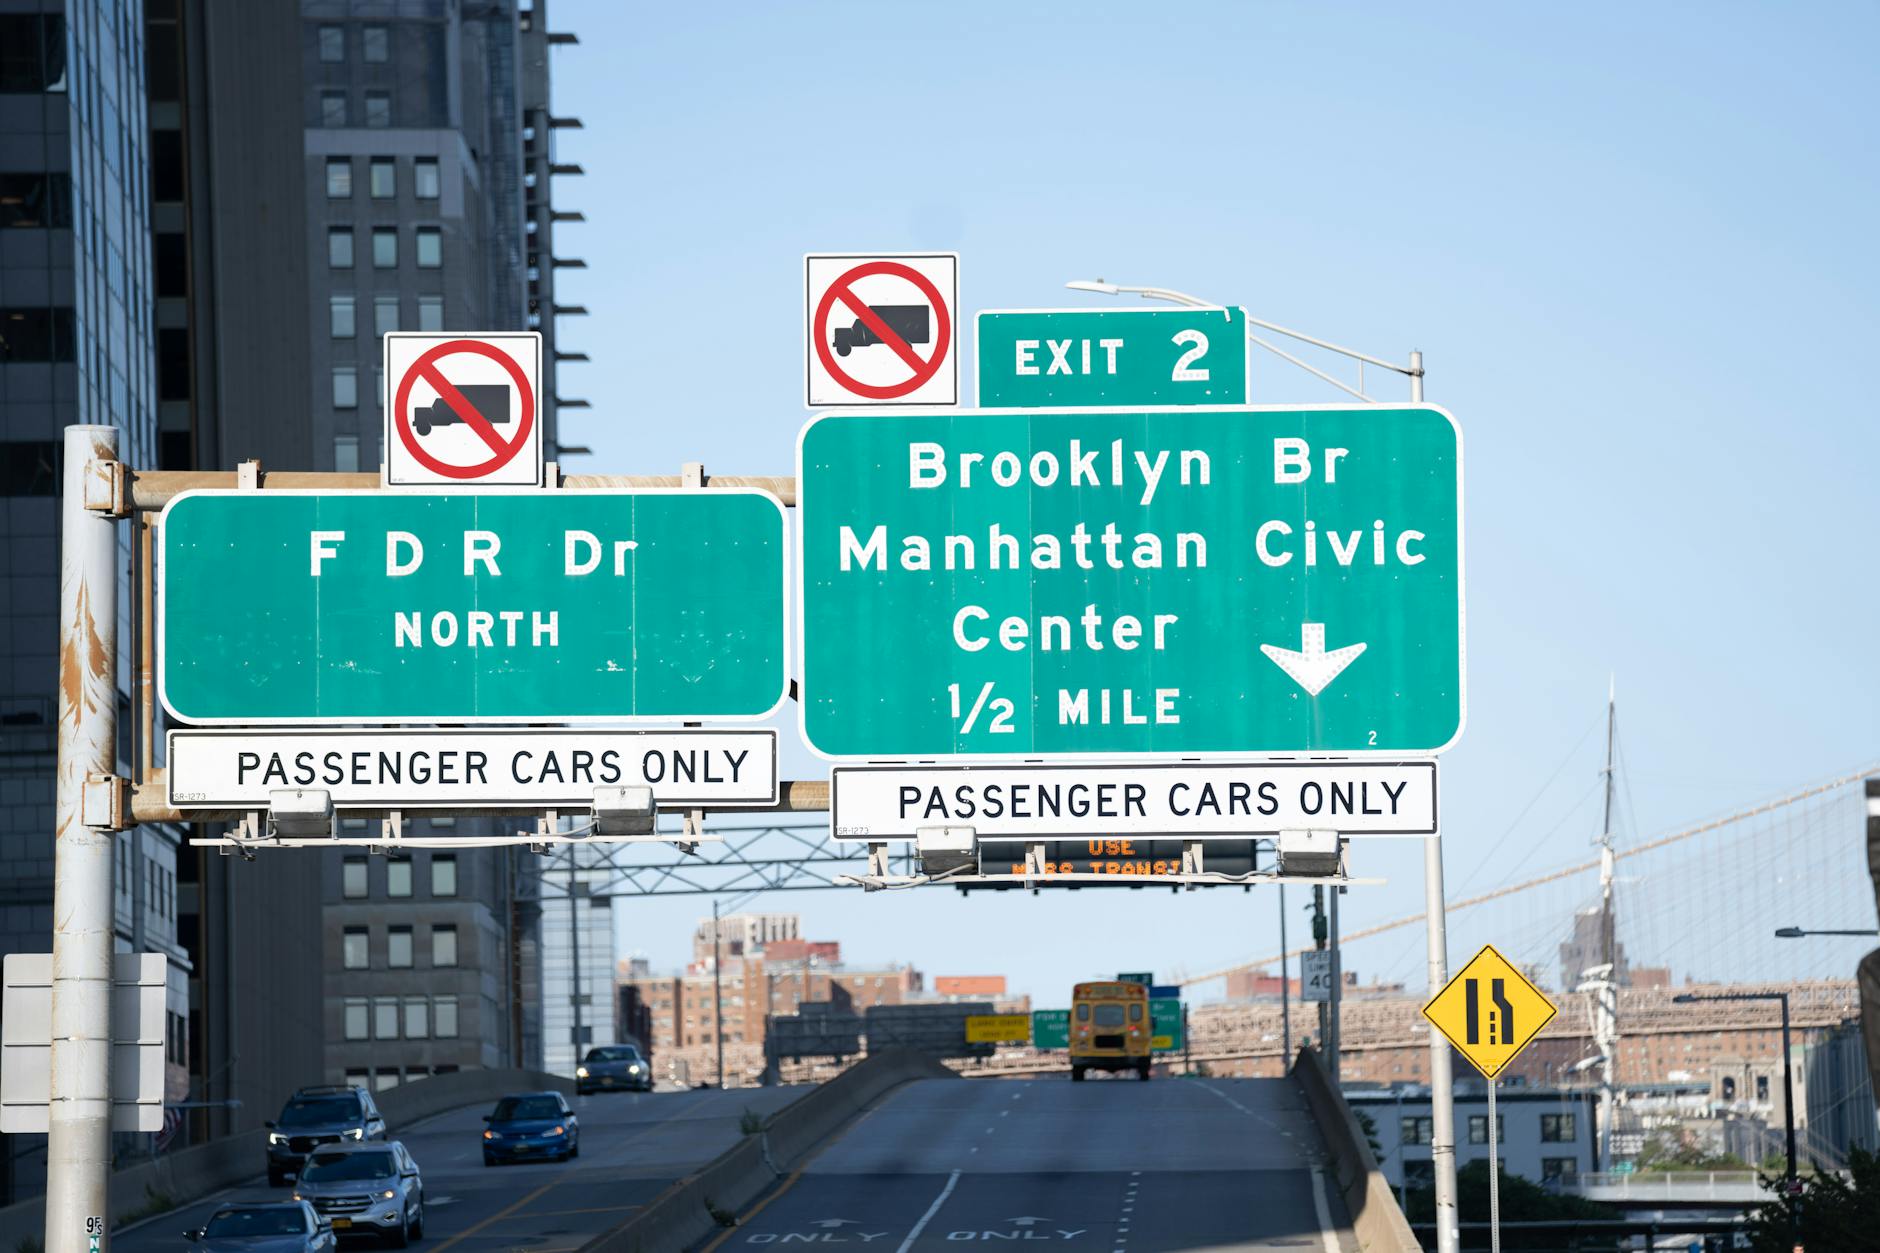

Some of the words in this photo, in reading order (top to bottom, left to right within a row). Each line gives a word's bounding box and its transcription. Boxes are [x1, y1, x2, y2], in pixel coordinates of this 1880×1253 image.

[1015, 339, 1124, 376] EXIT
[1171, 329, 1210, 381] 2
[909, 438, 1211, 505] Brooklyn
[1273, 437, 1349, 484] Br
[310, 530, 345, 576] F
[386, 530, 424, 576] D
[463, 530, 502, 577] R
[564, 530, 639, 576] Dr
[839, 522, 1207, 572] Manhattan
[1255, 519, 1426, 567] Civic
[394, 610, 559, 648] NORTH
[952, 603, 1179, 652] Center
[947, 682, 1015, 734] 1/2
[1058, 688, 1180, 725] MILE
[1368, 730, 1377, 746] 2
[238, 751, 488, 786] PASSENGER
[511, 750, 621, 784] CARS
[642, 749, 749, 783] ONLY
[174, 792, 206, 801] SR-1273
[899, 783, 1146, 819] PASSENGER
[1168, 781, 1279, 817] CARS
[1300, 781, 1407, 815] ONLY
[838, 827, 869, 835] SR-1273
[1088, 840, 1136, 856] USE
[746, 1232, 889, 1243] ONLY
[946, 1229, 1088, 1241] ONLY
